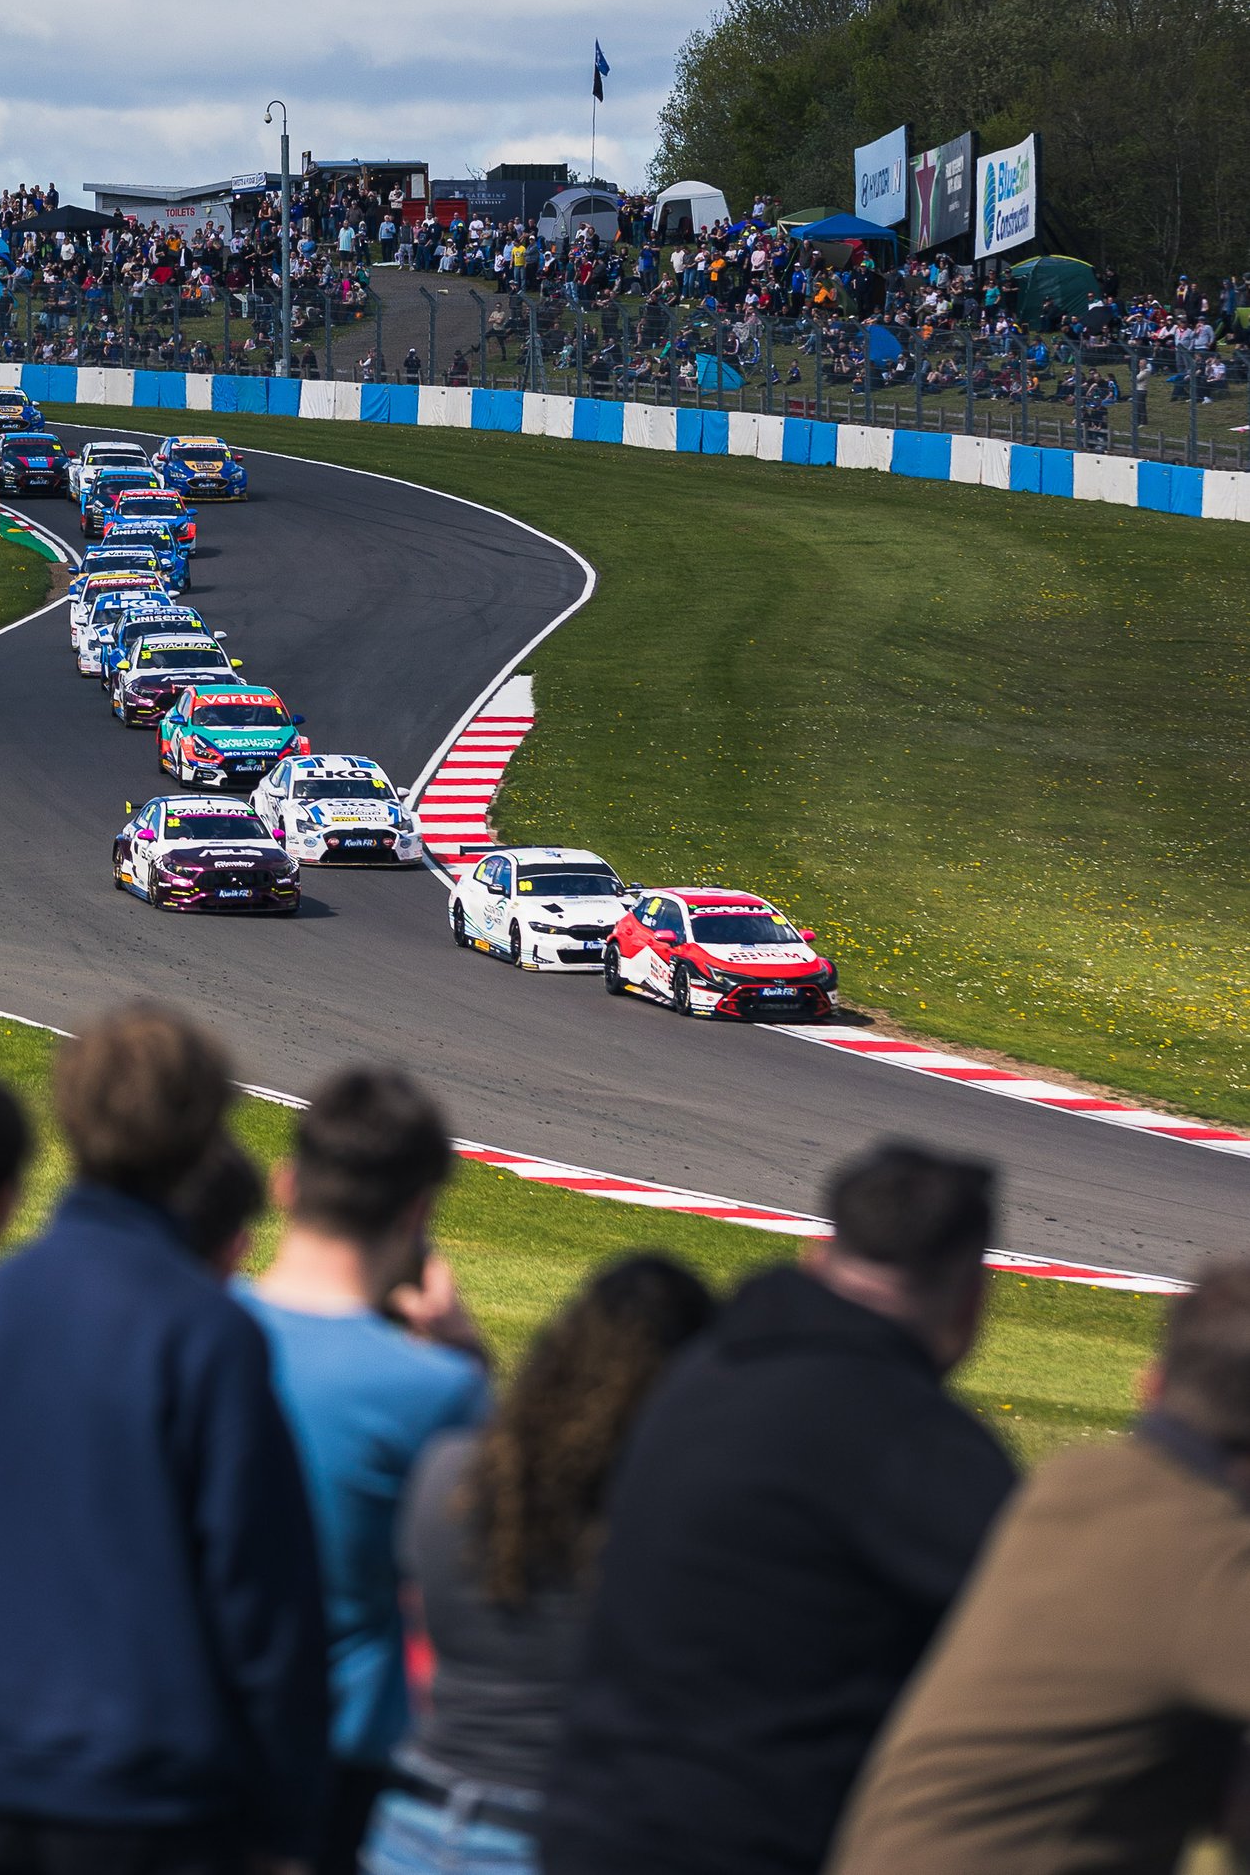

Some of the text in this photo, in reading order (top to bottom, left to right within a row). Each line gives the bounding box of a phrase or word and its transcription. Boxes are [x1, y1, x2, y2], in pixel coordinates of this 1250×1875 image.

[165, 207, 195, 217] TOILETS
[104, 600, 160, 609] LKQ
[148, 642, 211, 650] CATACLEAN
[202, 694, 263, 705] Vertu
[306, 770, 373, 779] LKQ
[173, 809, 249, 817] CATACLEAN
[167, 817, 181, 828] 32
[199, 849, 264, 857] ASUS
[518, 880, 533, 892] 99
[694, 905, 773, 914] COROLLA
[757, 952, 801, 960] DCM
